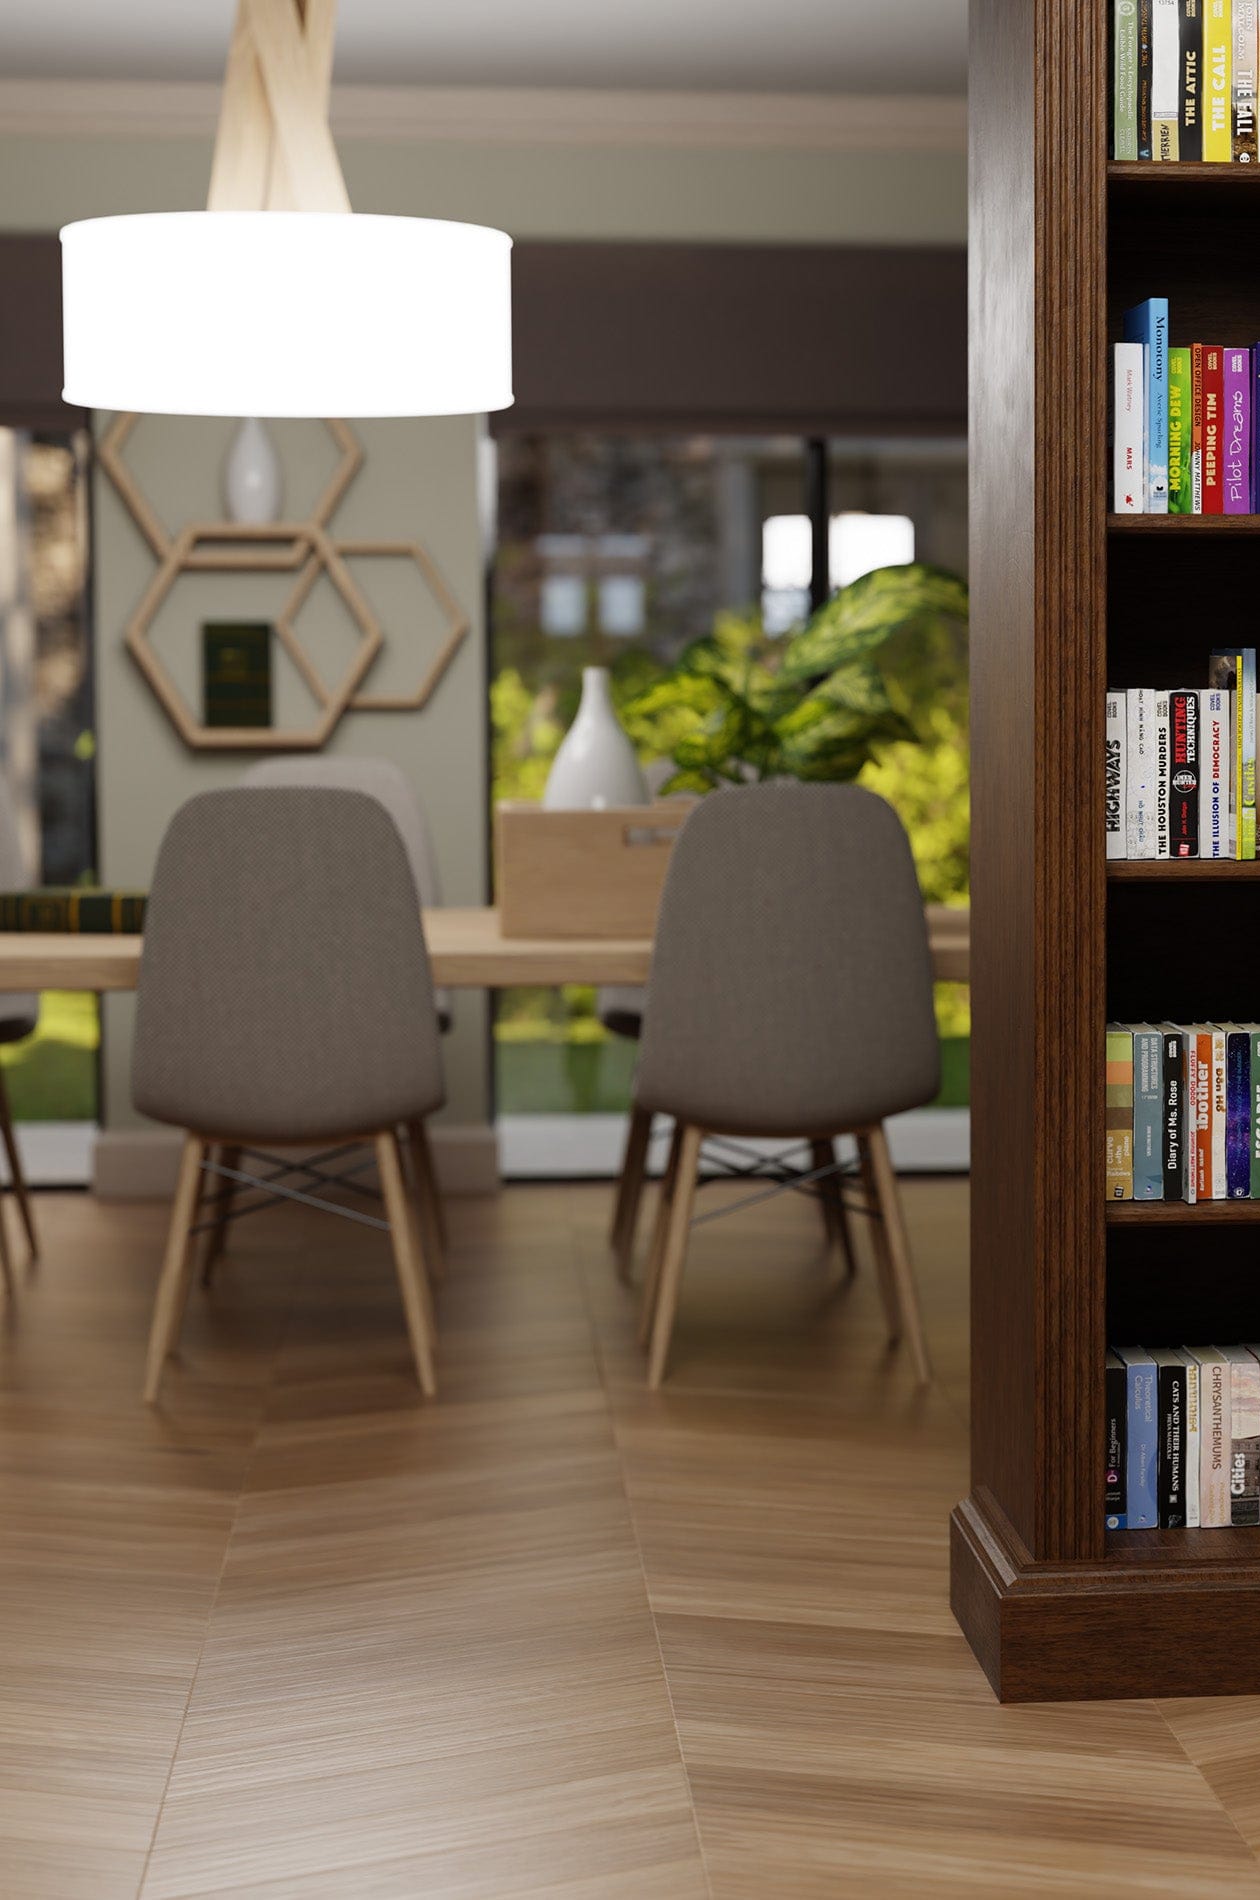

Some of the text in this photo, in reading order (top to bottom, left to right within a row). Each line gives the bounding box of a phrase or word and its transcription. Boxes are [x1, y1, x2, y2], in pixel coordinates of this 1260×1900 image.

[1185, 50, 1196, 127] THE ATTIC
[1212, 44, 1226, 131] THE CALL
[1237, 69, 1253, 135] THE FALL
[1153, 316, 1166, 381] Monotony
[1169, 384, 1181, 491] MORNING DEW
[1206, 393, 1217, 486] PEEPING TIM
[1226, 390, 1243, 502] Pilot Dreams
[1175, 697, 1186, 764] HUNTING
[1187, 697, 1195, 764] TECHNIQUES
[1212, 721, 1220, 780] DEMOCRACY
[1106, 741, 1120, 833] HIGHWAYS
[1158, 728, 1167, 856] THE HOUSTON MURDERS
[1212, 782, 1219, 795] OF
[1244, 758, 1255, 806] Castles
[1141, 1037, 1149, 1092] AND PROGRAMMING
[1168, 1080, 1179, 1169] Diary of Ms. Rose
[1135, 1375, 1143, 1410] Calculus
[1144, 1375, 1153, 1422] Theoretical
[1212, 1366, 1222, 1470] CHRYSANTHEMUMS
[1108, 1418, 1118, 1467] For Beginners
[1231, 1452, 1245, 1495] Cities
